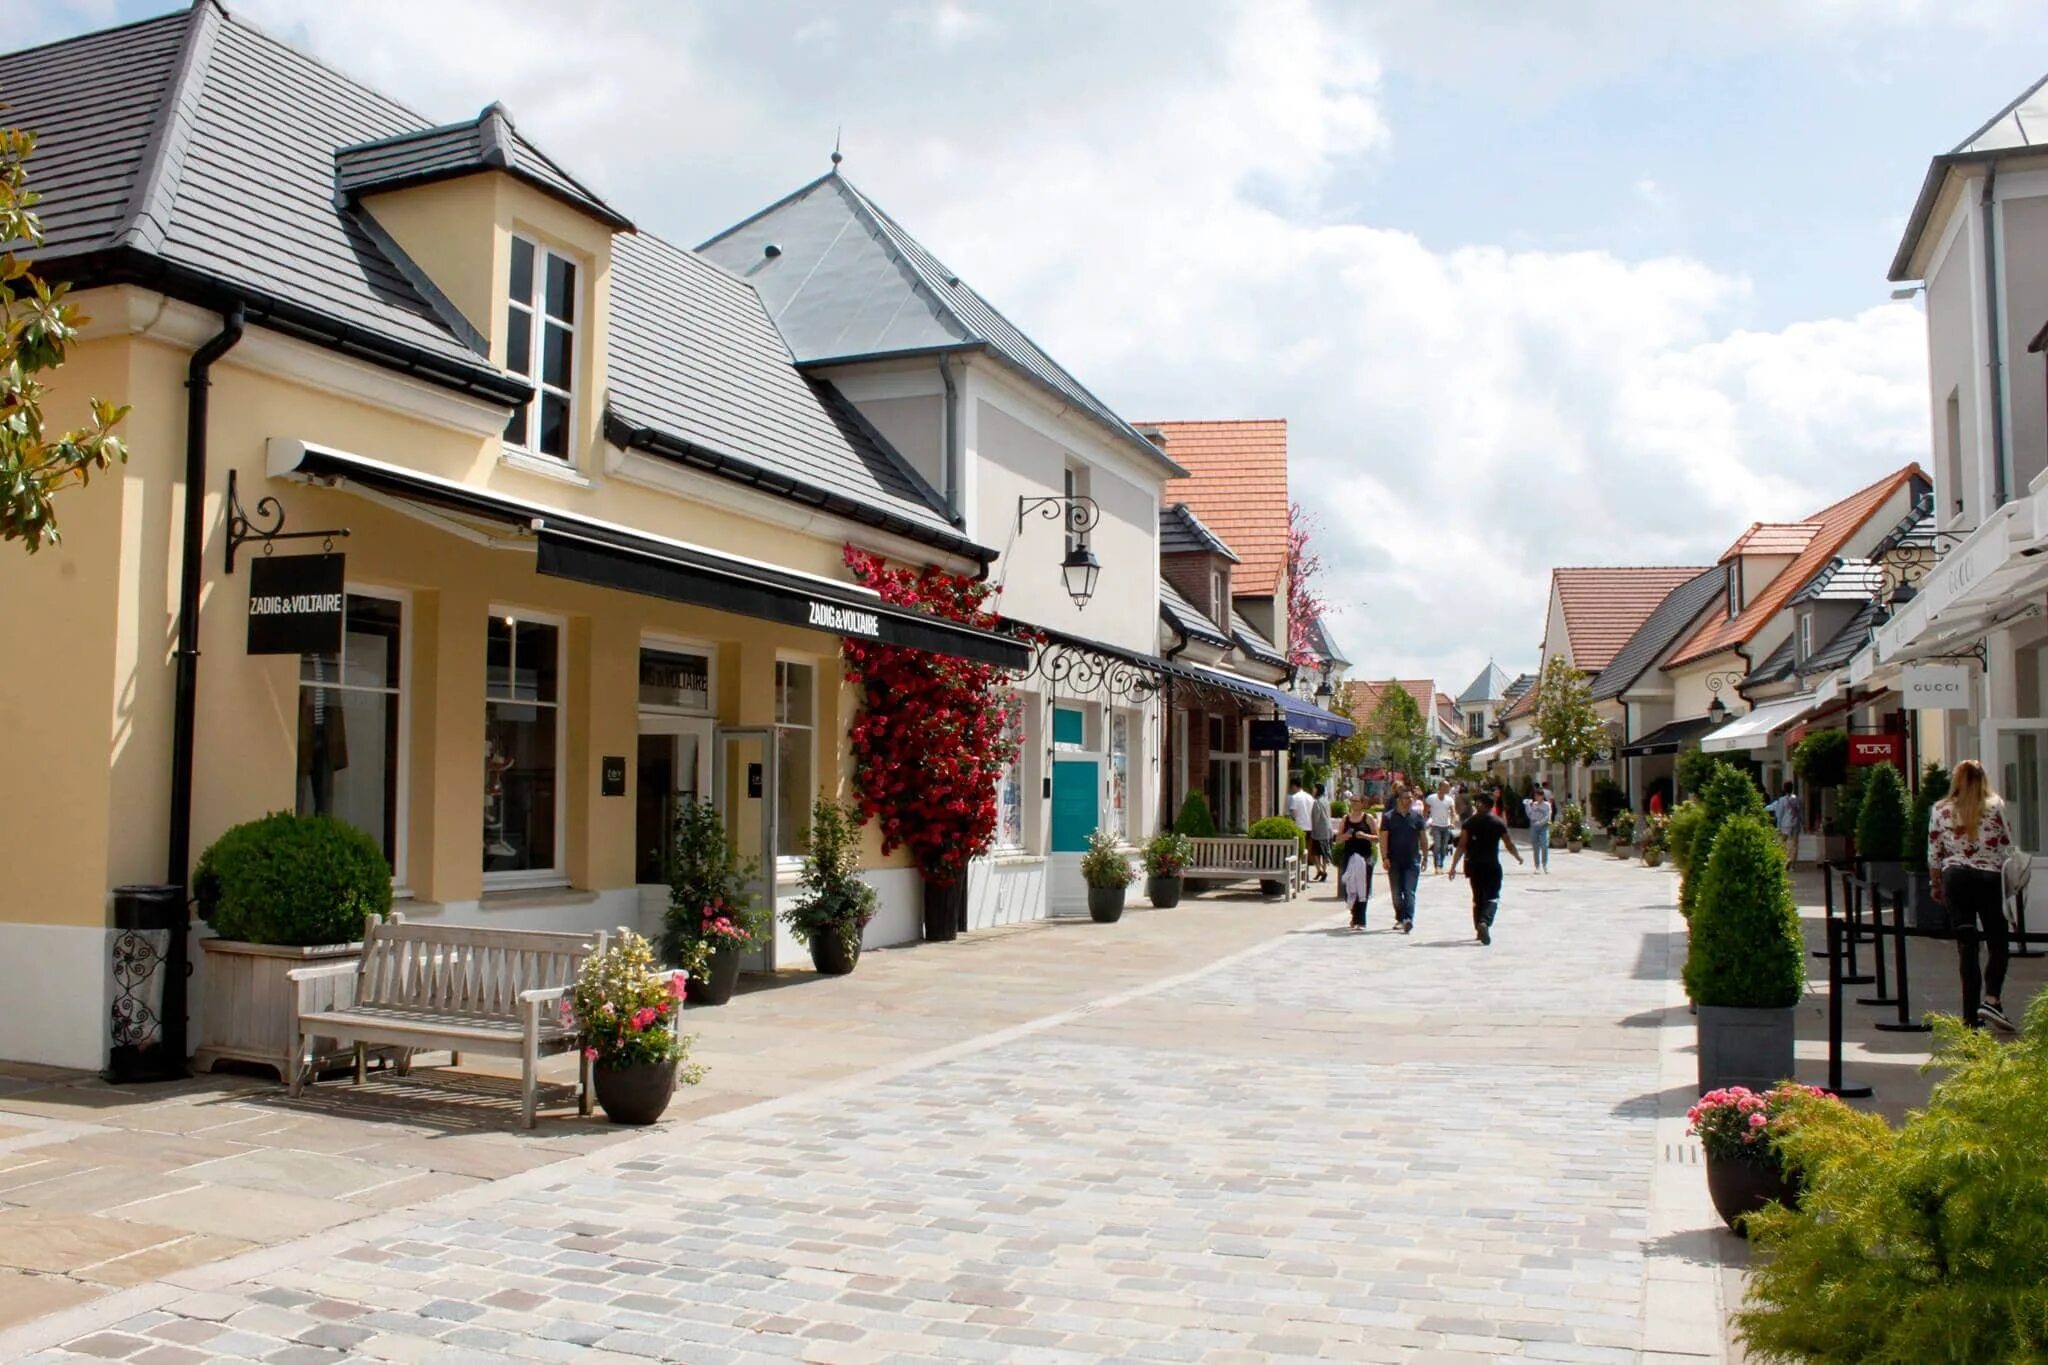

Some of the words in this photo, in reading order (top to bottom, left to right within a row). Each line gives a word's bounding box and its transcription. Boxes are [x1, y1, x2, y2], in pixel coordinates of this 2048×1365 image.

[249, 594, 342, 615] ZADIG&VOLTAIRE
[808, 601, 879, 636] ZADIG&VOLTAIRE
[1913, 683, 1959, 692] GUCCI
